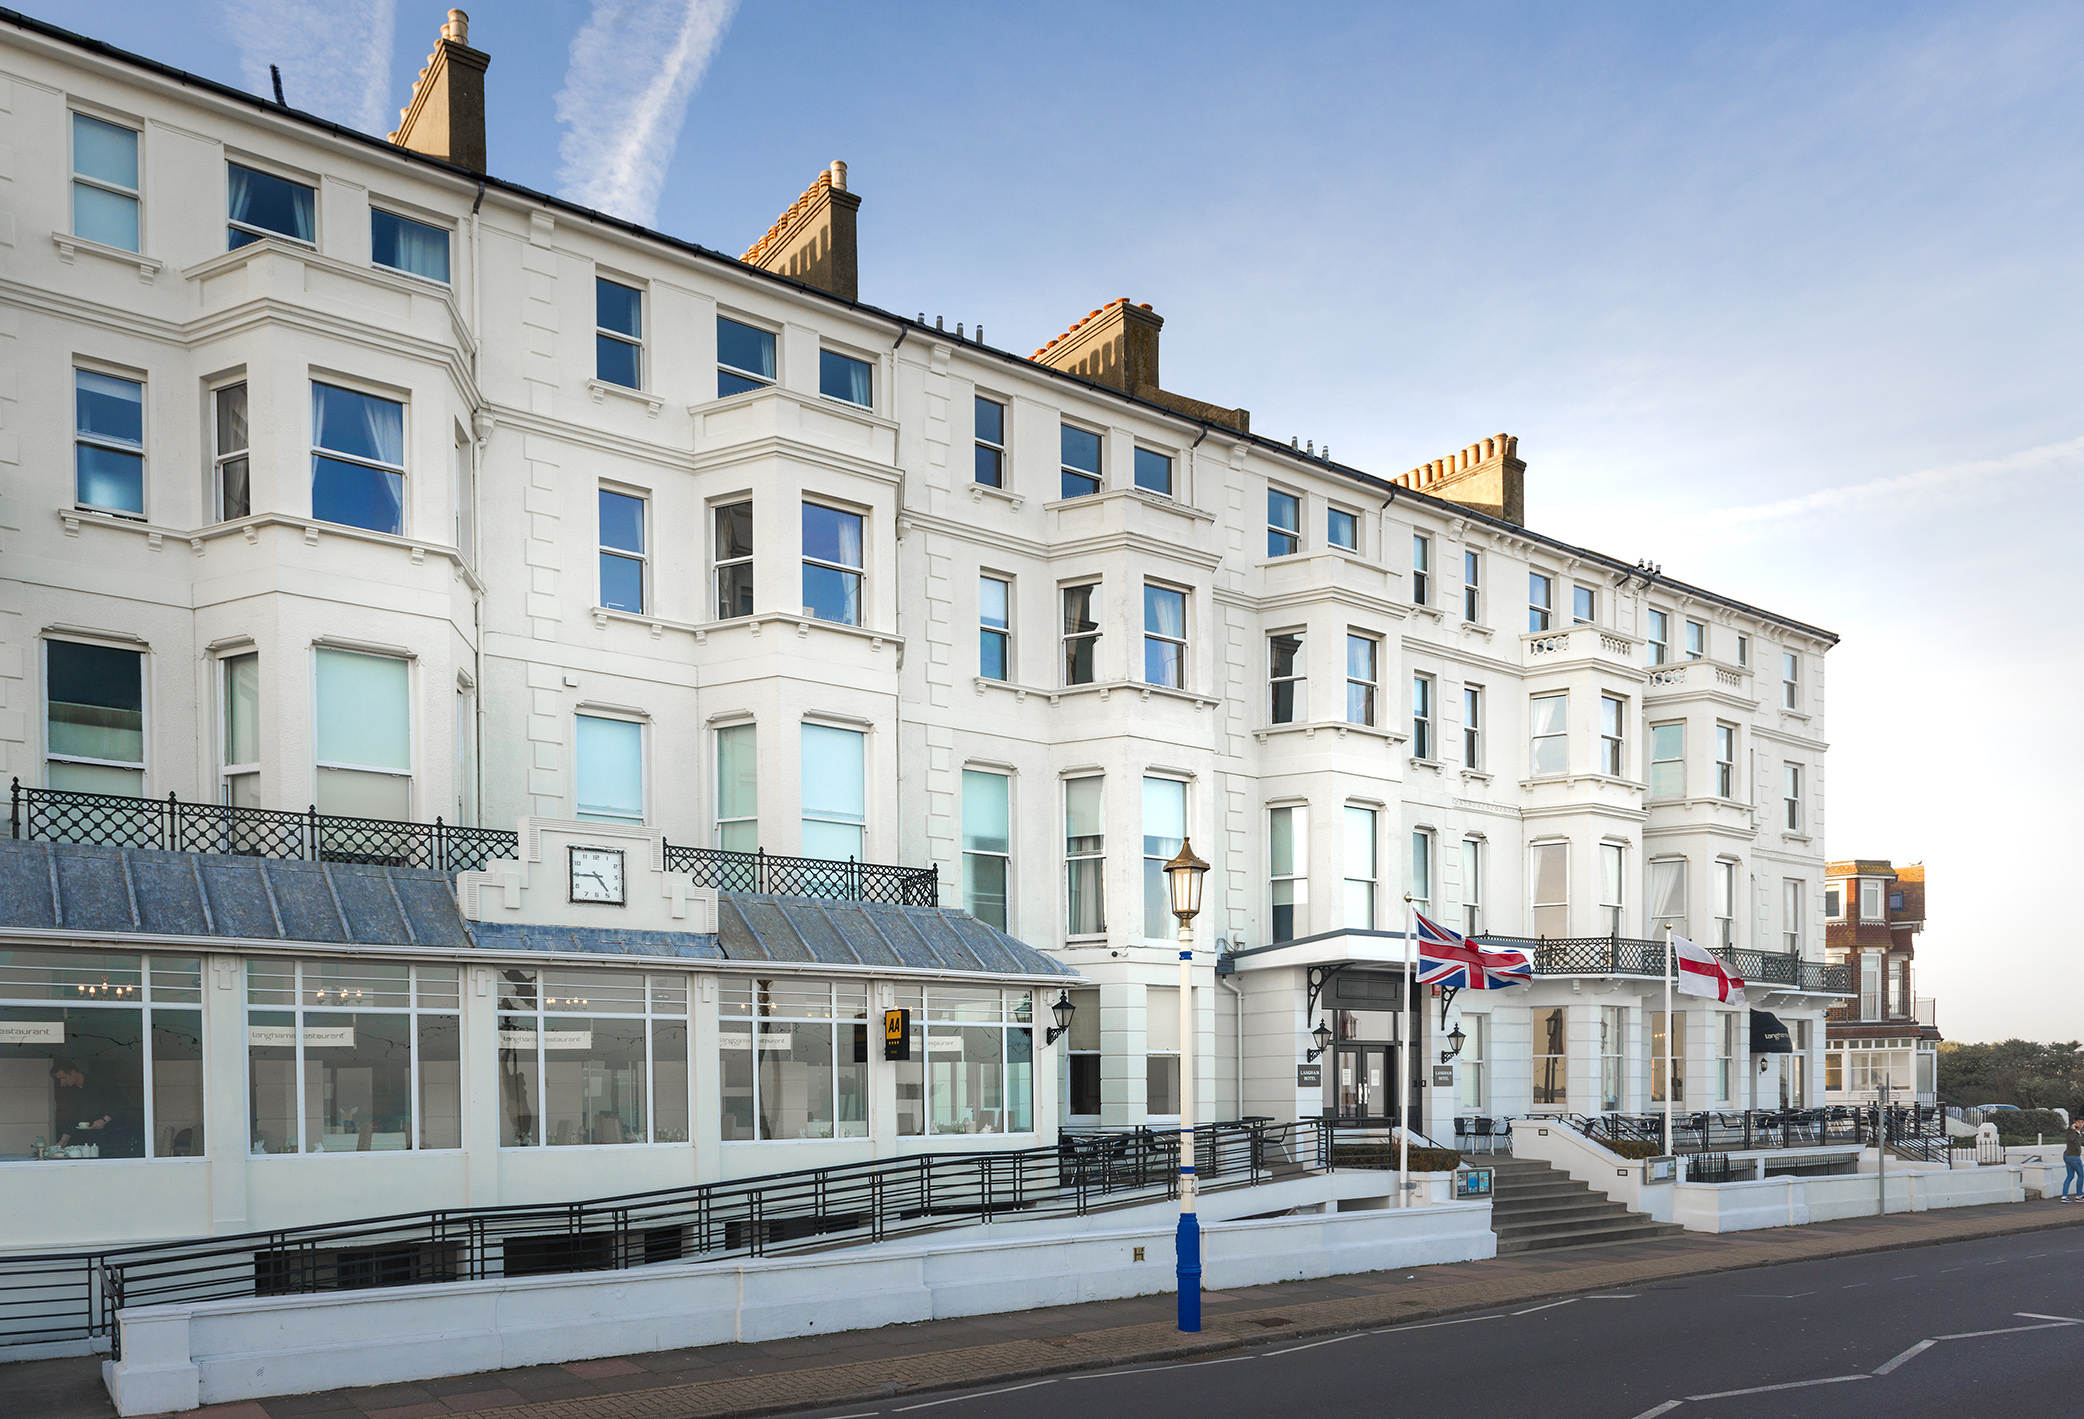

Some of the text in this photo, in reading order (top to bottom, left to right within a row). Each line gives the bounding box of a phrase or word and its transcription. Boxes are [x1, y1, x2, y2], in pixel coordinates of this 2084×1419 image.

[888, 1017, 900, 1034] AA
[0, 1028, 50, 1036] estaurant
[303, 1032, 345, 1040] estaurant
[503, 1036, 538, 1044] langham
